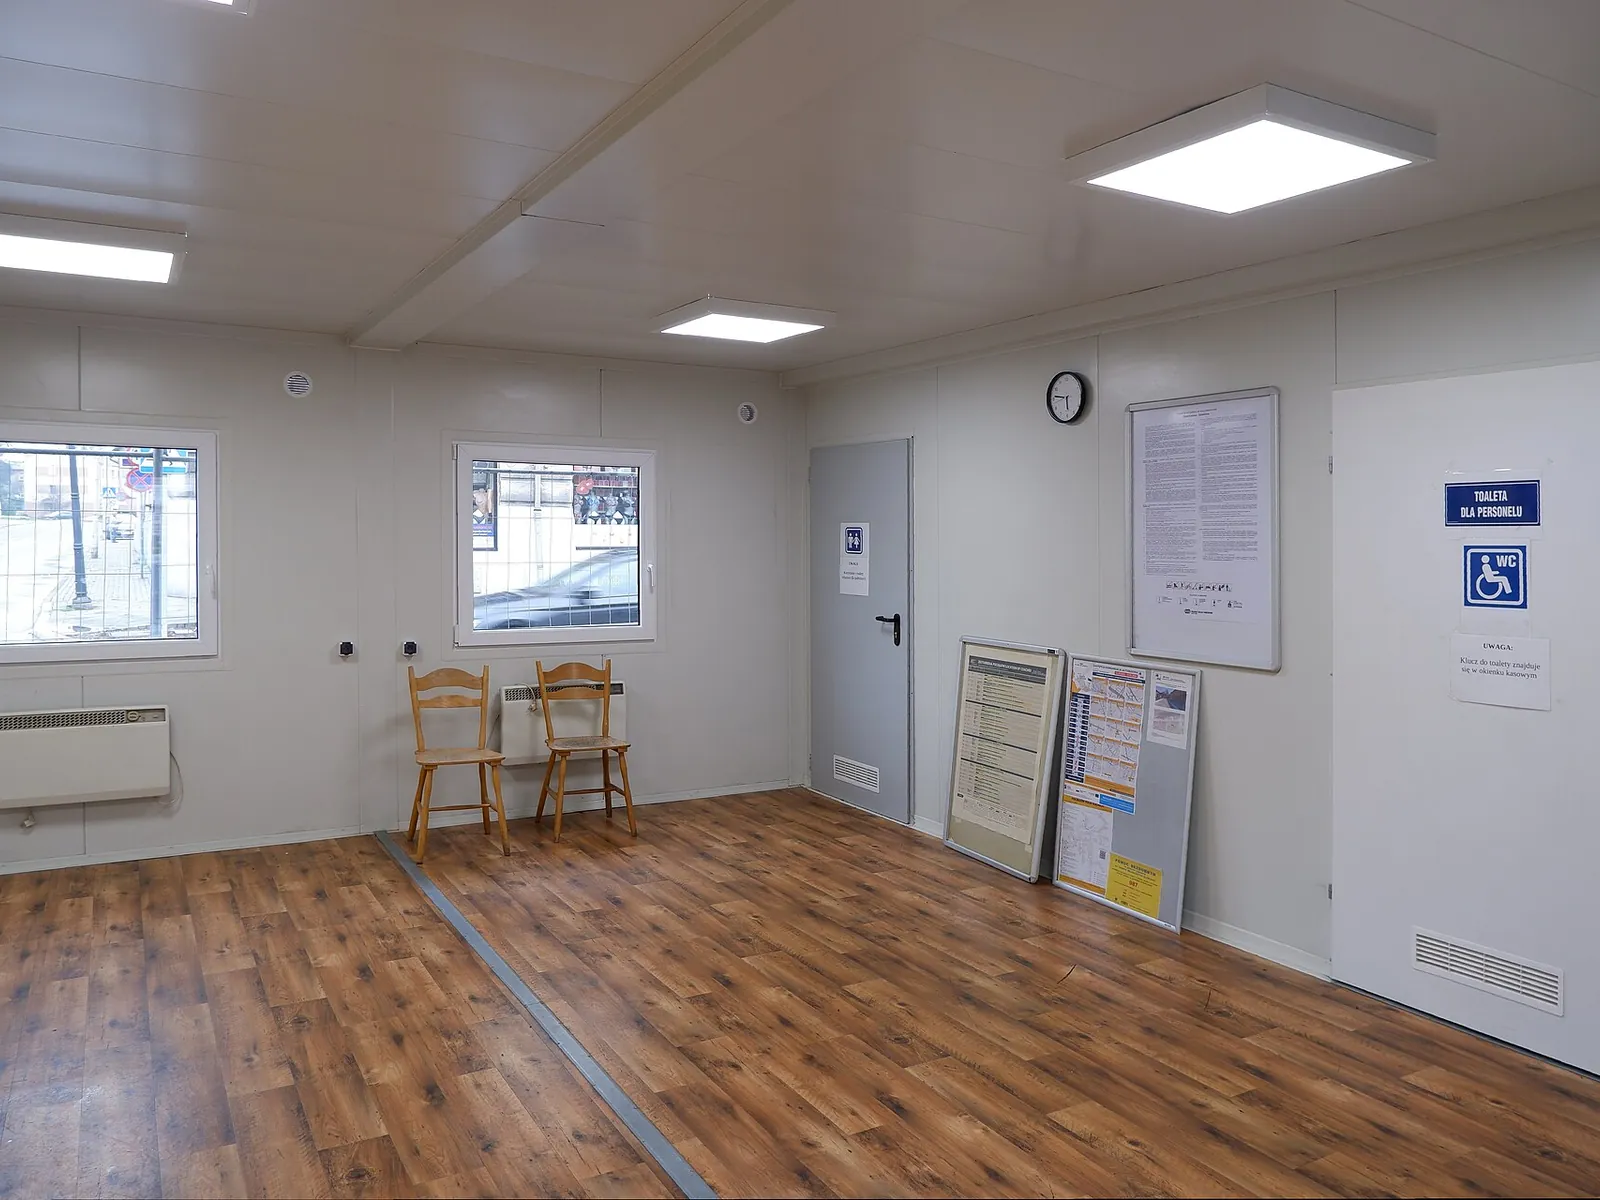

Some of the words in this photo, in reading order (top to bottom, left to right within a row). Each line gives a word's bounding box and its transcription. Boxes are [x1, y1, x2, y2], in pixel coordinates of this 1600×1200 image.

[1474, 490, 1508, 502] TOALETA
[1460, 507, 1475, 518] DLA
[1477, 506, 1523, 518] PERSONELU
[1496, 555, 1517, 568] WC
[1483, 643, 1513, 651] UWAGA:
[1460, 657, 1478, 665] Klucz
[1489, 660, 1511, 668] toalety
[1512, 662, 1541, 670] znajduje
[1479, 668, 1505, 676] okienku
[1505, 670, 1538, 679] kasowym
